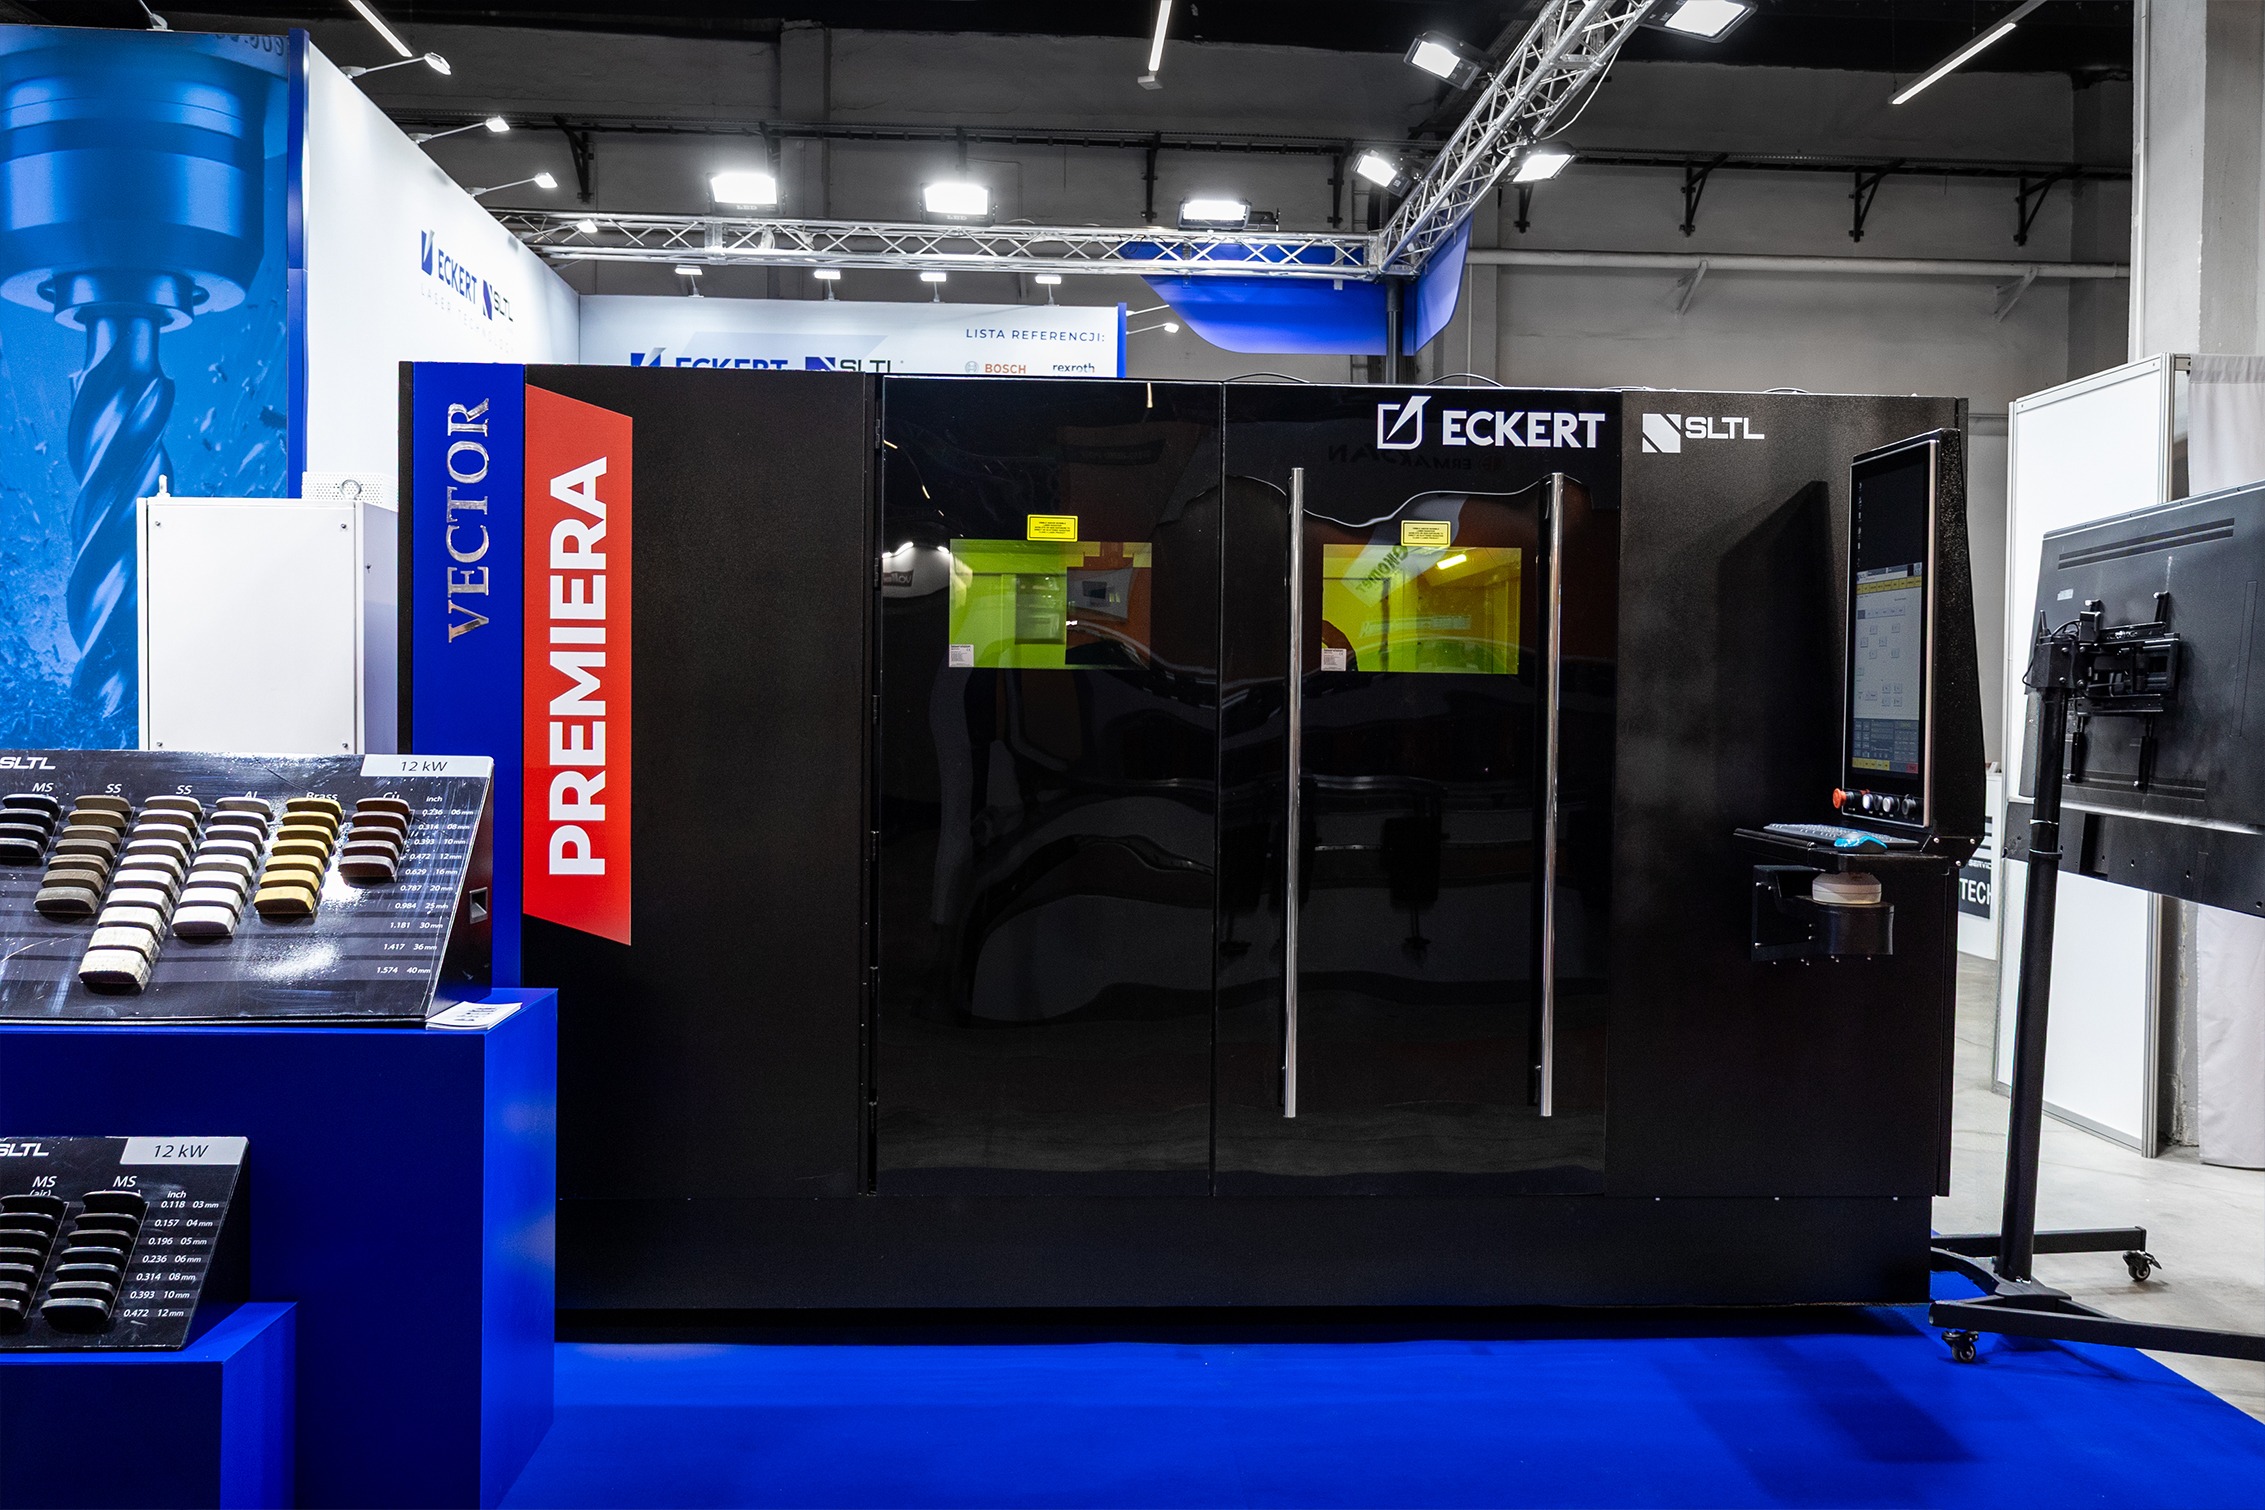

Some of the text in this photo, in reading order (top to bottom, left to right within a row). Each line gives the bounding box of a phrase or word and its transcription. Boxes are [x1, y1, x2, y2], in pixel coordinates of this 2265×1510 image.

[438, 248, 513, 322] ECKERT SLTL
[966, 329, 1105, 342] LISTA REFERENCJI:
[985, 363, 1095, 374] BOSCH rexroth
[1442, 410, 1605, 448] ECKERT
[1685, 416, 1765, 440] SLTL
[447, 397, 490, 643] VECTOR
[549, 456, 607, 875] PREMIERA
[0, 756, 56, 770] SLTL
[400, 761, 448, 772] 12 kW
[32, 782, 54, 792] MS
[105, 783, 122, 793] SS
[175, 785, 193, 795] SS
[305, 791, 338, 800] Brass
[0, 1143, 50, 1157] SLTL
[154, 1144, 209, 1158] 12 kW
[31, 1176, 58, 1188] MS
[112, 1176, 138, 1188] MS
[167, 1190, 187, 1198] inch
[160, 1200, 186, 1208] 0.118
[154, 1219, 180, 1227] 0.157
[148, 1237, 173, 1245] 0.196
[142, 1255, 168, 1263] 0.236
[136, 1273, 162, 1281] 0.314
[129, 1291, 155, 1299] 0.393
[123, 1309, 149, 1317] 0.472
